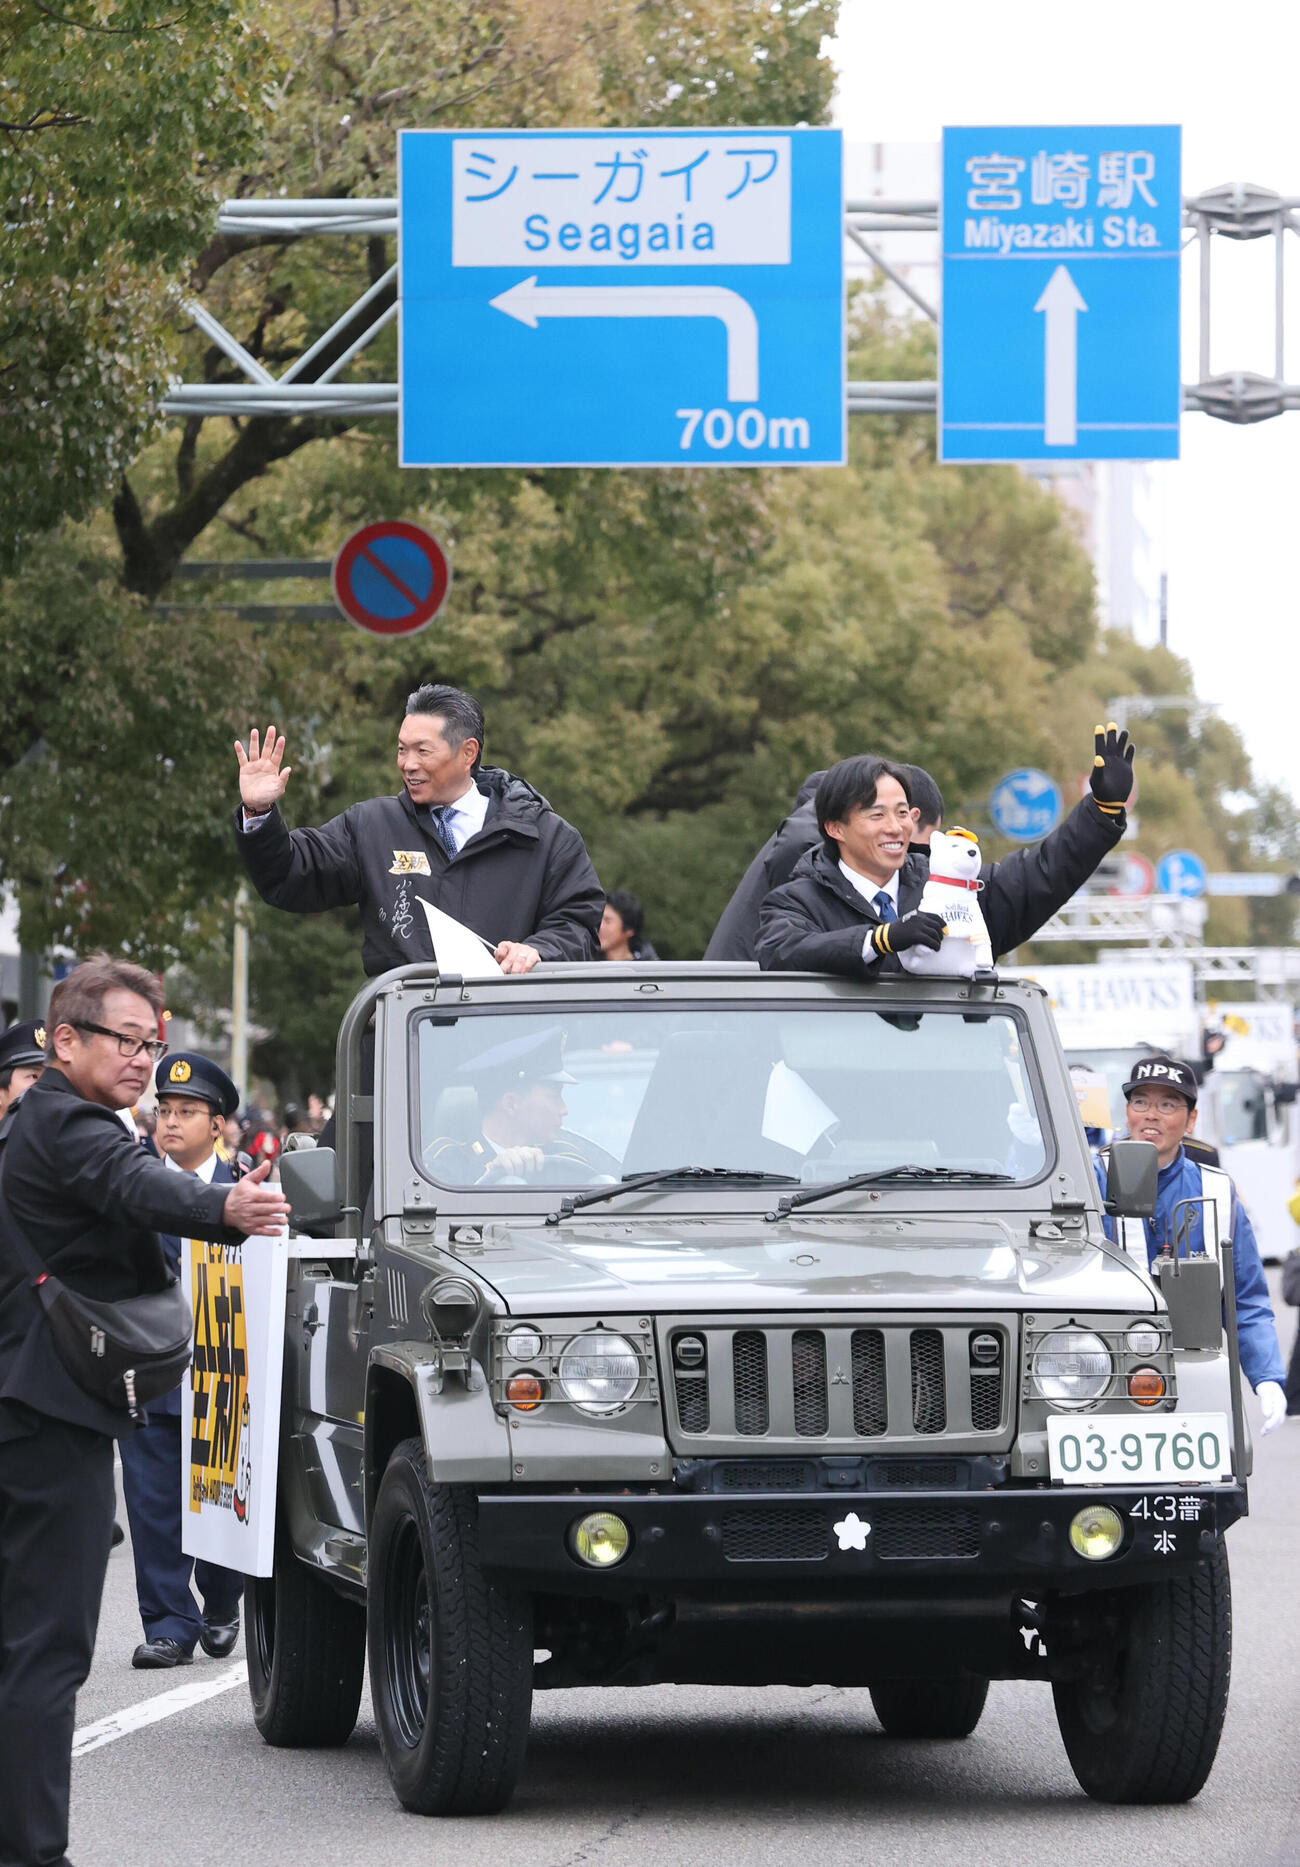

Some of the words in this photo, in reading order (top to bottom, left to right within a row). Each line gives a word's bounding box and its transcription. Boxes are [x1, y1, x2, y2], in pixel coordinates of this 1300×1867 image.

[465, 148, 778, 204] シーガイア
[965, 150, 1158, 210] 宮崎駅
[524, 213, 715, 260] Seagaia
[964, 216, 1094, 255] Miyazaki
[1102, 215, 1161, 248] Sta.
[676, 407, 810, 450] 700m
[1078, 976, 1181, 1011] HAWKS
[1136, 1064, 1184, 1084] NPK
[1059, 1432, 1221, 1472] 03-9760
[1153, 1530, 1176, 1554] 本
